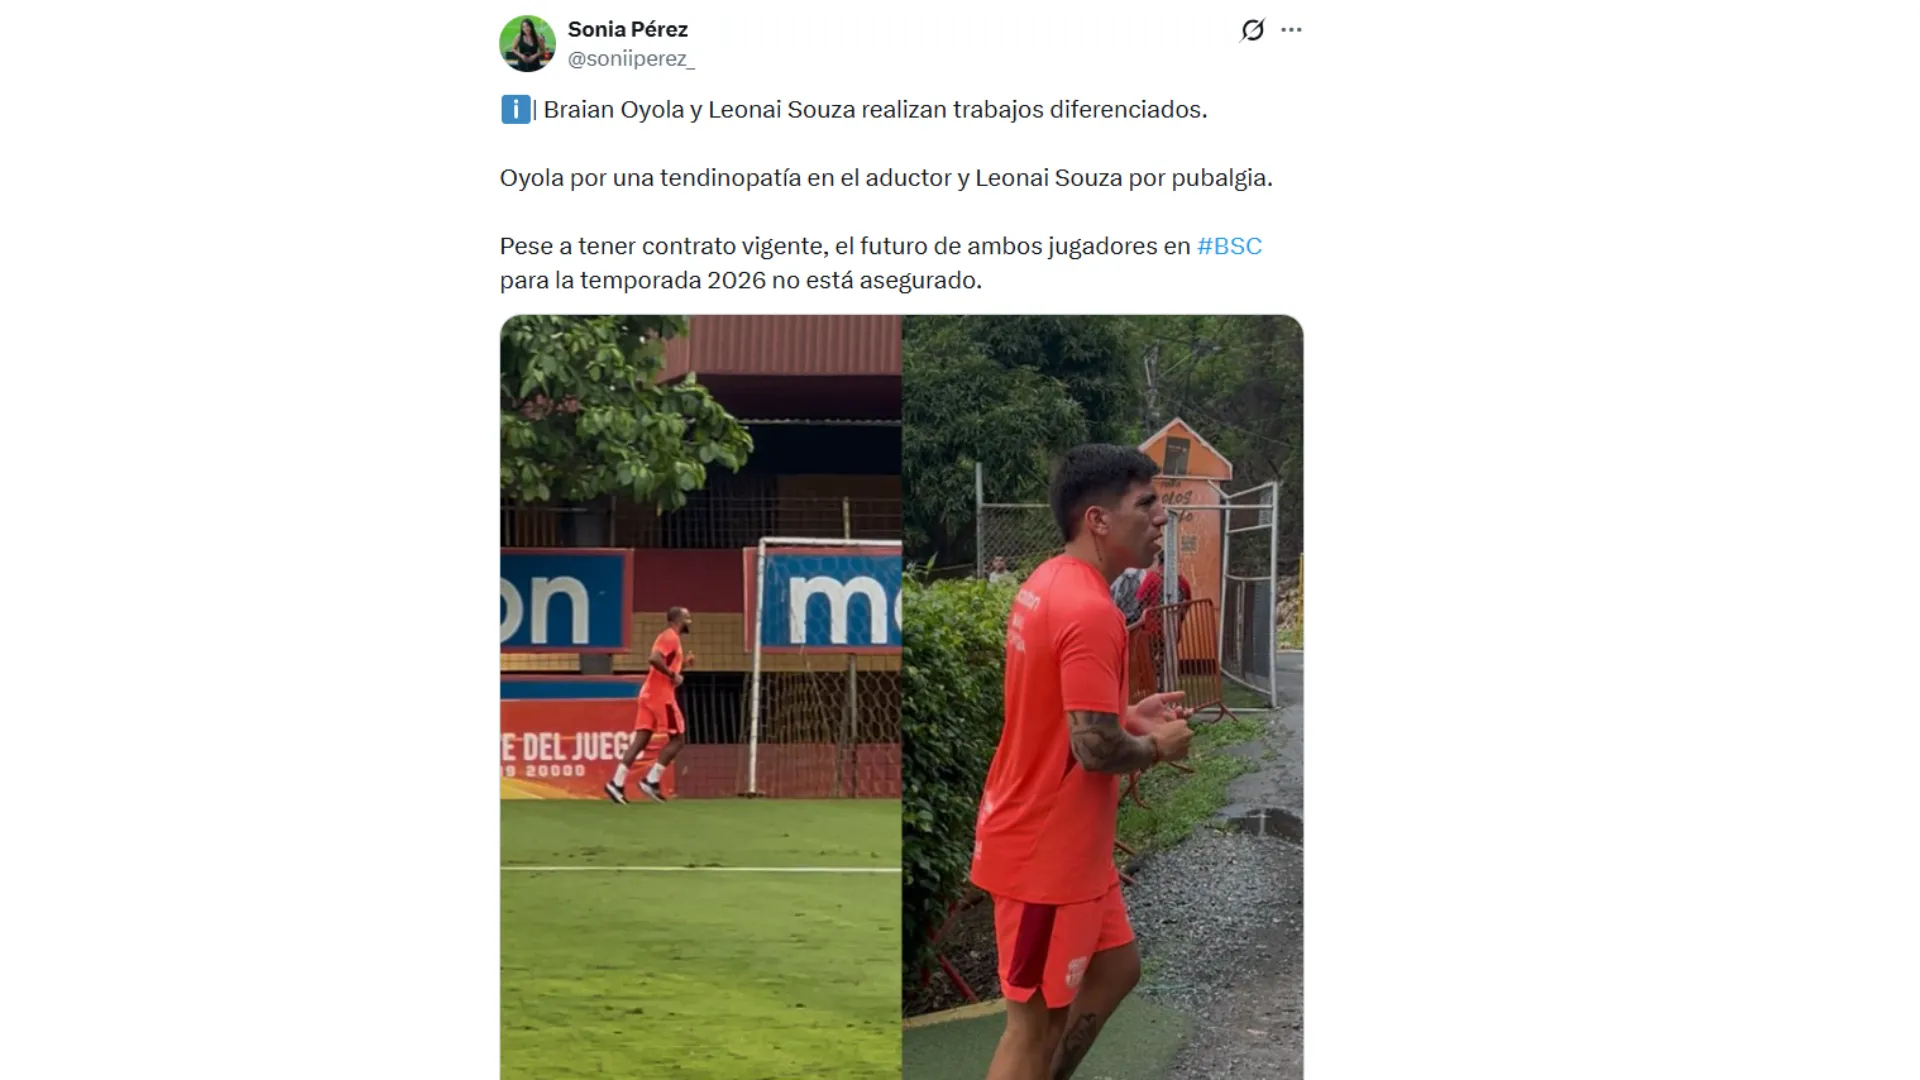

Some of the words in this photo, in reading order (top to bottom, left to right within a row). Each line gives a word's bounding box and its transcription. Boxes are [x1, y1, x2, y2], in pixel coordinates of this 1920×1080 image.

[567, 19, 627, 38] Sonia
[631, 19, 689, 38] Pérez
[568, 48, 696, 71] @soniiperez_
[543, 99, 614, 119] Braian
[620, 99, 685, 124] Oyola
[689, 104, 704, 124] y
[709, 99, 782, 119] Leonai
[787, 100, 856, 119] Souza
[862, 99, 947, 119] realizan
[952, 99, 1044, 124] trabajos
[1049, 99, 1208, 119] diferenciados.
[499, 167, 565, 192] Oyola
[570, 172, 608, 192] por
[613, 172, 654, 187] una
[659, 167, 801, 192] tendinopatía
[807, 172, 835, 187] en
[840, 167, 859, 187] el
[865, 167, 953, 187] aductor
[957, 172, 971, 192] y
[976, 167, 1049, 187] Leonai
[1054, 168, 1123, 187] Souza
[1129, 172, 1167, 192] por
[1172, 167, 1273, 192] pubalgia.
[500, 236, 554, 255] Pese
[559, 240, 573, 256] a
[577, 237, 637, 256] tener
[641, 237, 737, 255] contrato
[741, 235, 829, 261] vigente,
[835, 235, 855, 255] el
[859, 235, 928, 256] futuro
[933, 235, 962, 255] de
[967, 235, 1043, 255] ambos
[1046, 235, 1158, 261] jugadores
[1163, 240, 1191, 255] en
[1197, 236, 1263, 255] #BSC
[500, 274, 549, 295] para
[555, 269, 575, 290] la
[579, 269, 702, 295] temporada
[707, 271, 767, 290] 2026
[772, 274, 801, 290] no
[805, 269, 854, 290] está
[859, 269, 982, 295] asegurado.
[790, 576, 902, 644] m
[500, 732, 517, 761] E
[523, 732, 567, 761] DEL
[525, 764, 586, 777] 20000
